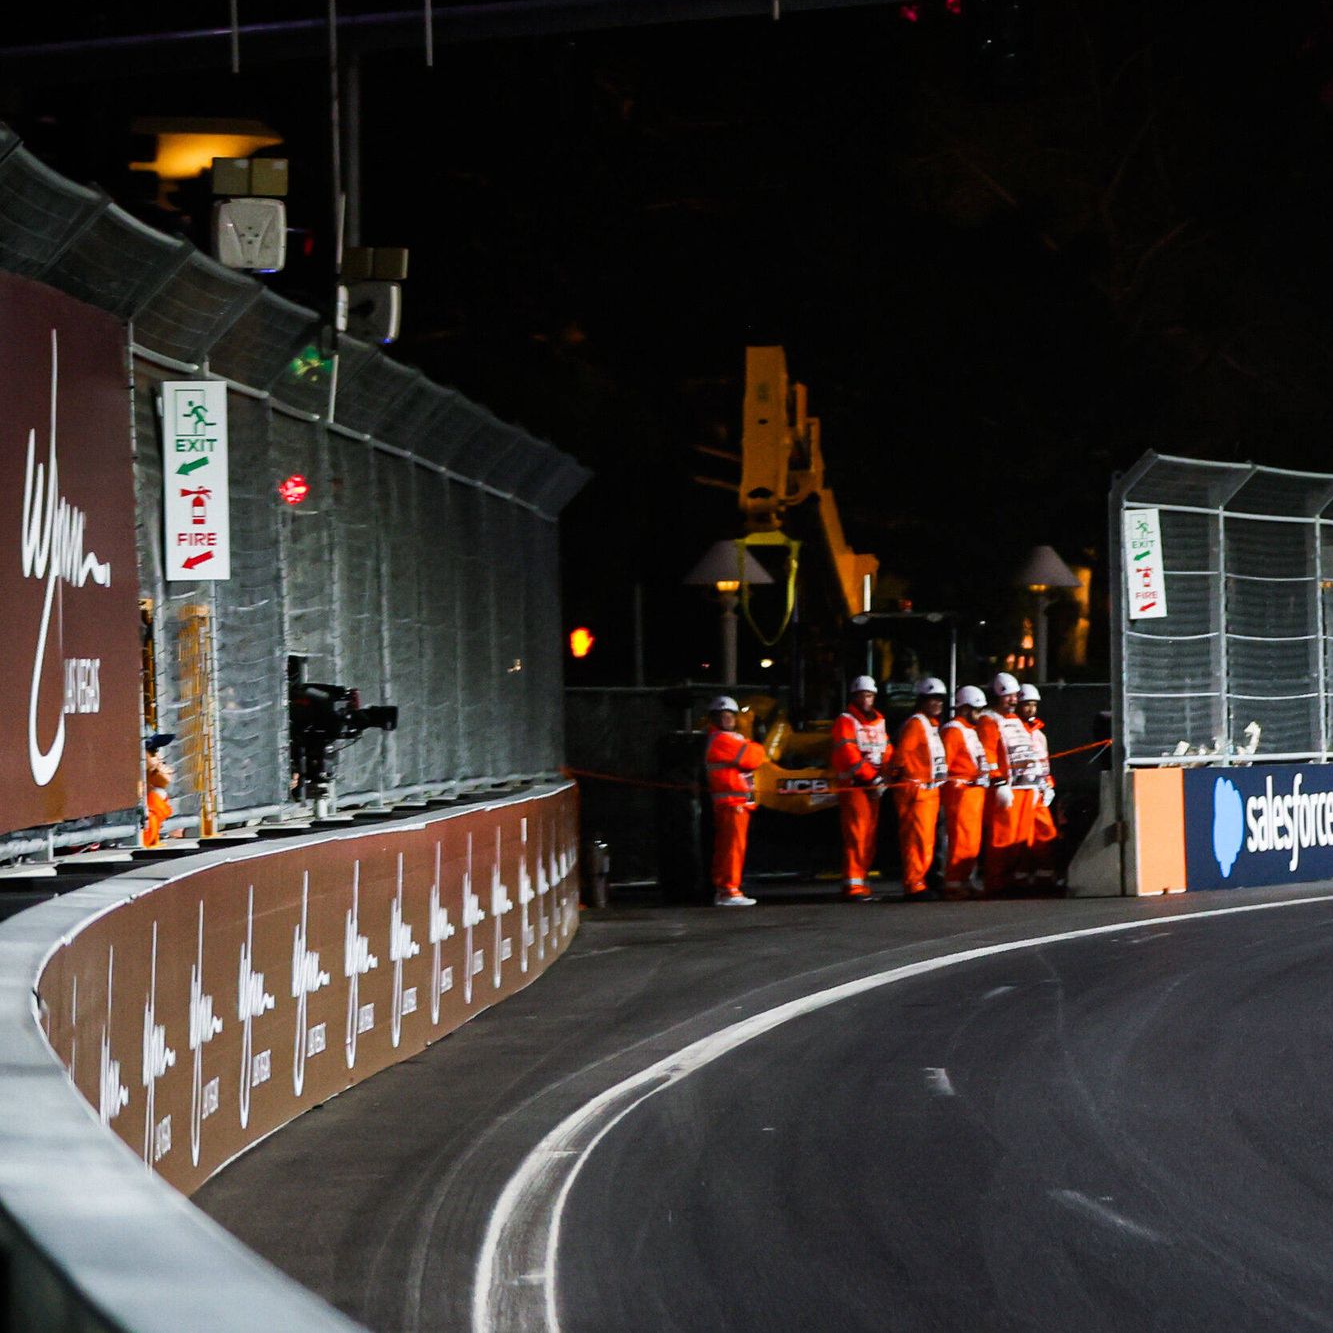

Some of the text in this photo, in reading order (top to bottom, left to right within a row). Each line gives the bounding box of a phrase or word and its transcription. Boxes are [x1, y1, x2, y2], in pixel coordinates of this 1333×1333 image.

[175, 438, 218, 453] EXIT
[176, 532, 218, 547] FIRE
[1131, 539, 1155, 549] EXIT
[1135, 590, 1158, 600] FIRE
[778, 779, 828, 794] JCB
